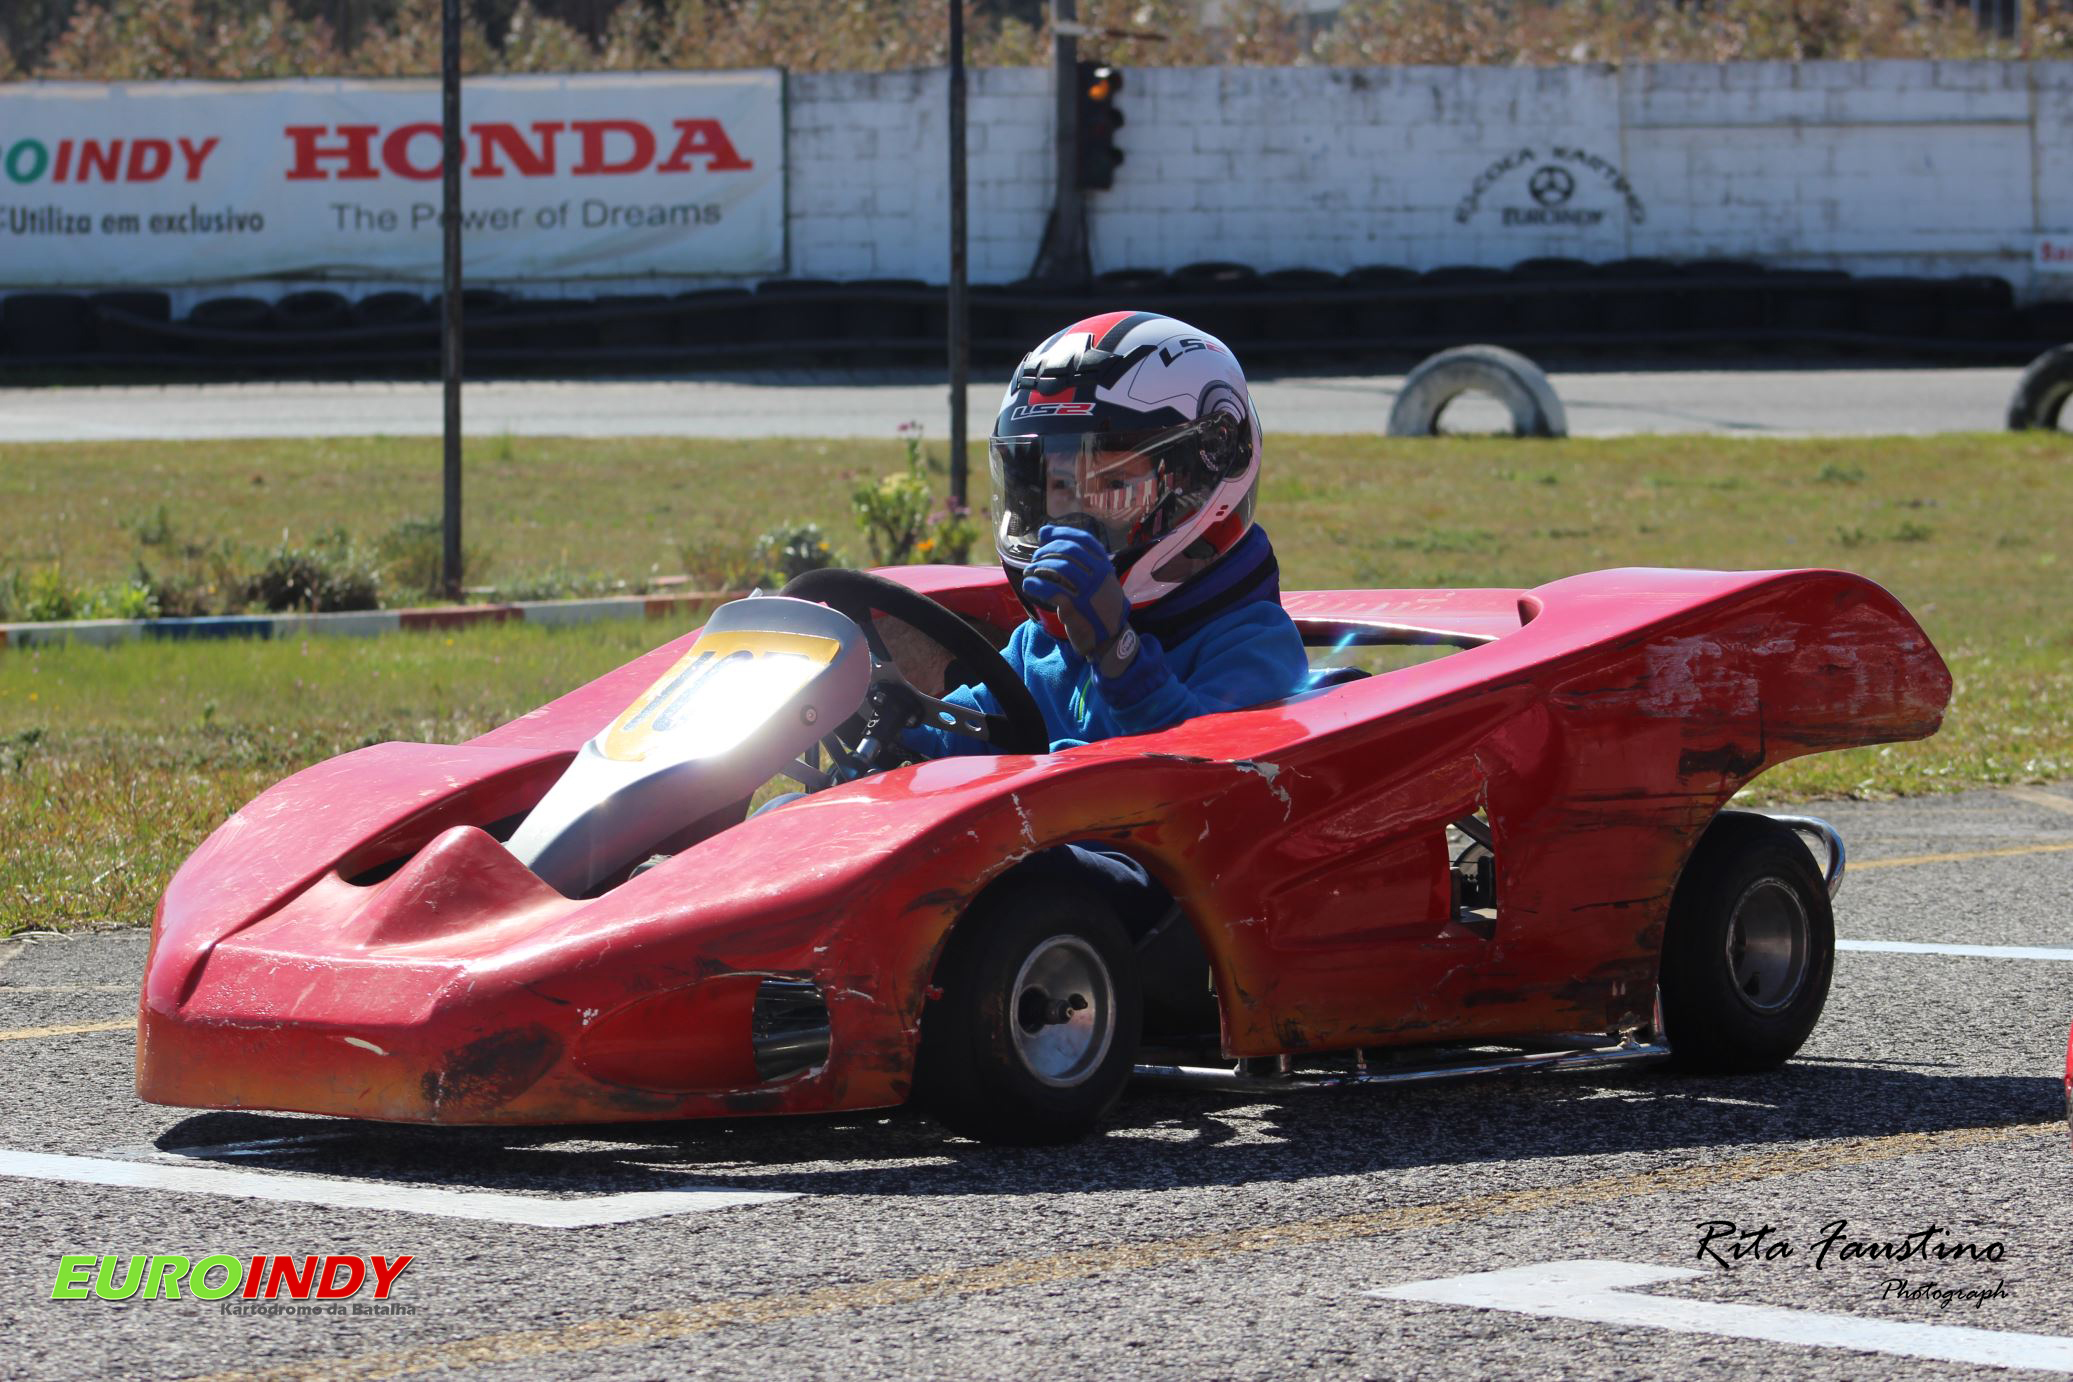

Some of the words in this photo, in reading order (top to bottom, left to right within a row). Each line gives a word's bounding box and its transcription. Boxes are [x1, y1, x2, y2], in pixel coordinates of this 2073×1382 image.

[0, 136, 221, 185] OINDY
[101, 212, 140, 235] em
[150, 203, 265, 235] exclusivo
[332, 203, 399, 231] The
[535, 201, 569, 226] of
[581, 198, 724, 228] Dreams
[1010, 402, 1097, 421] LS2
